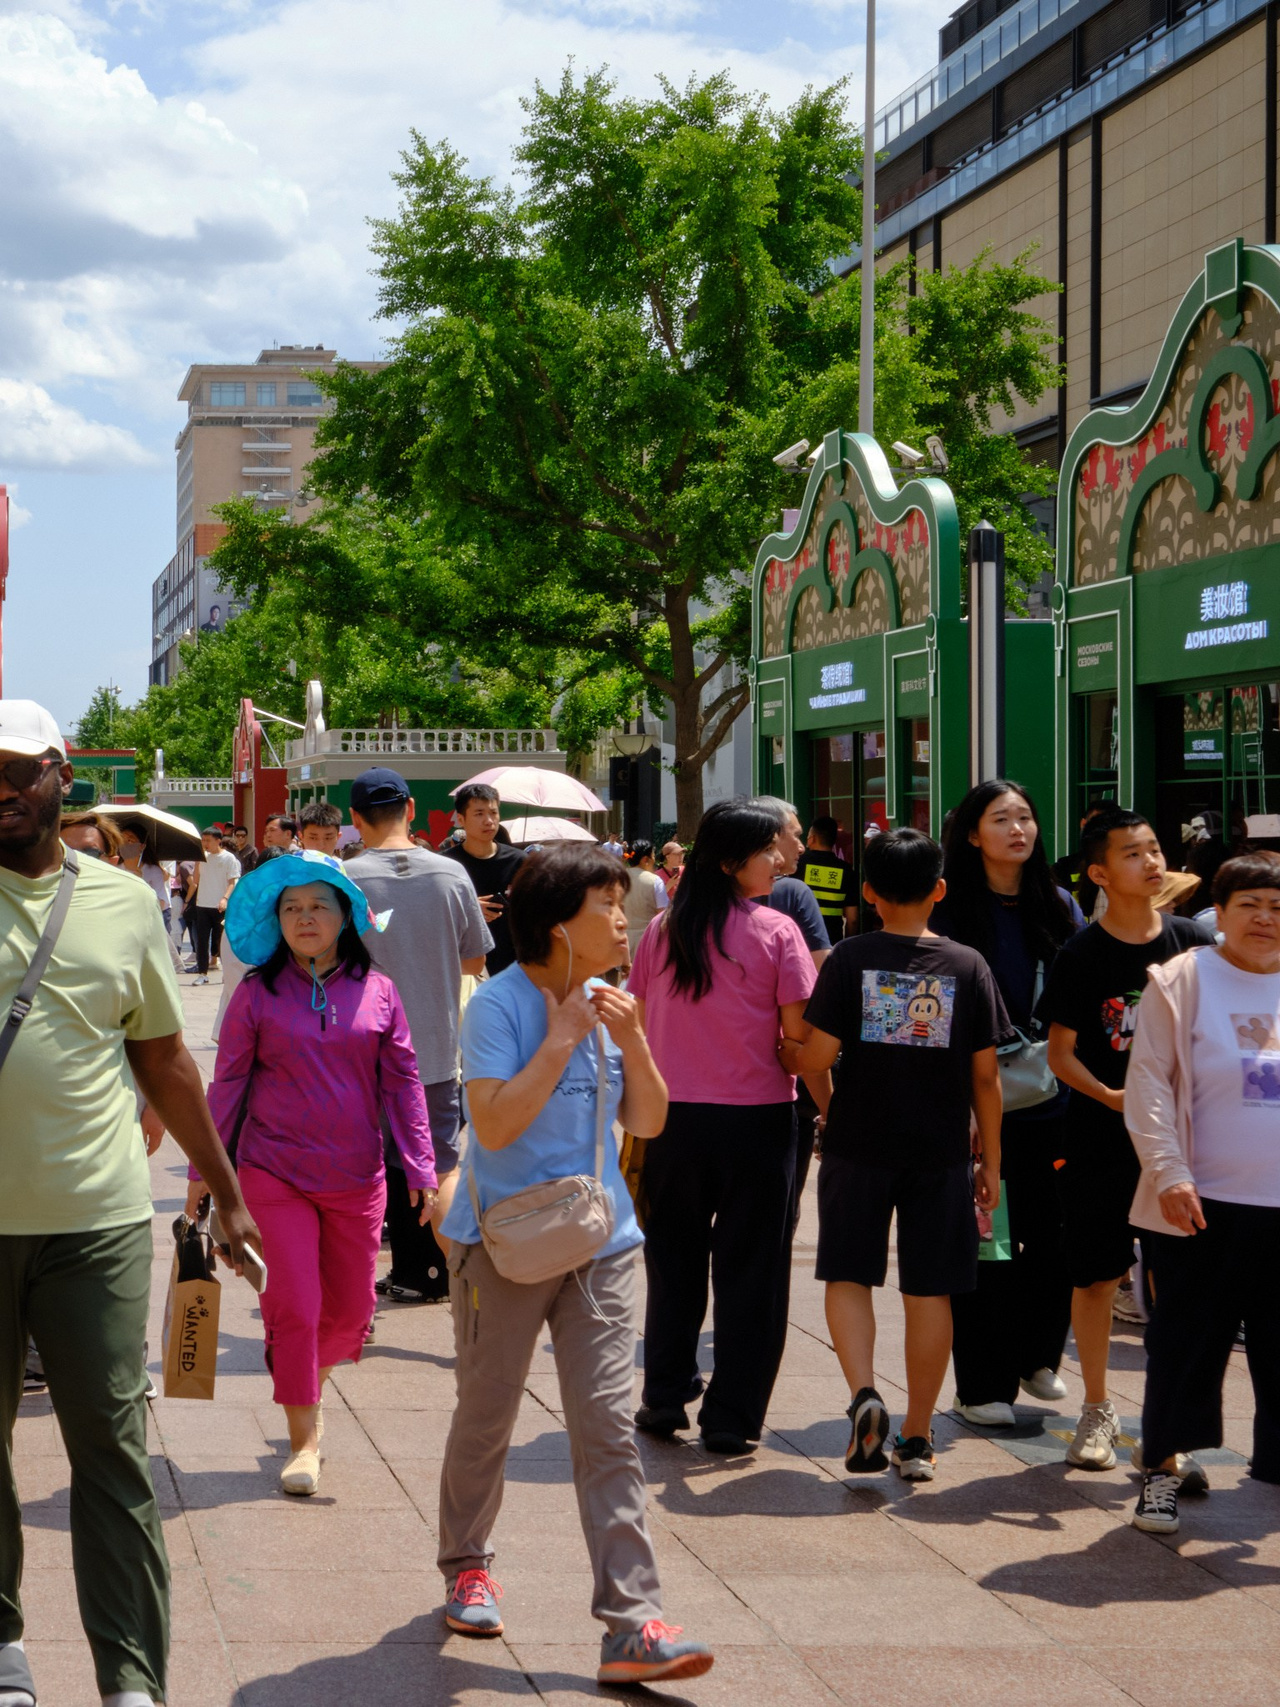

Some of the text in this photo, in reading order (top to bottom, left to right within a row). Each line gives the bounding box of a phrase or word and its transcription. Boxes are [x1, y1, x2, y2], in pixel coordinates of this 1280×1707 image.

[1200, 580, 1249, 622] 美妆馆
[1184, 620, 1267, 650] ДОМ КРАСОТЫ
[810, 867, 839, 881] 保安
[181, 1305, 200, 1372] WANTED
